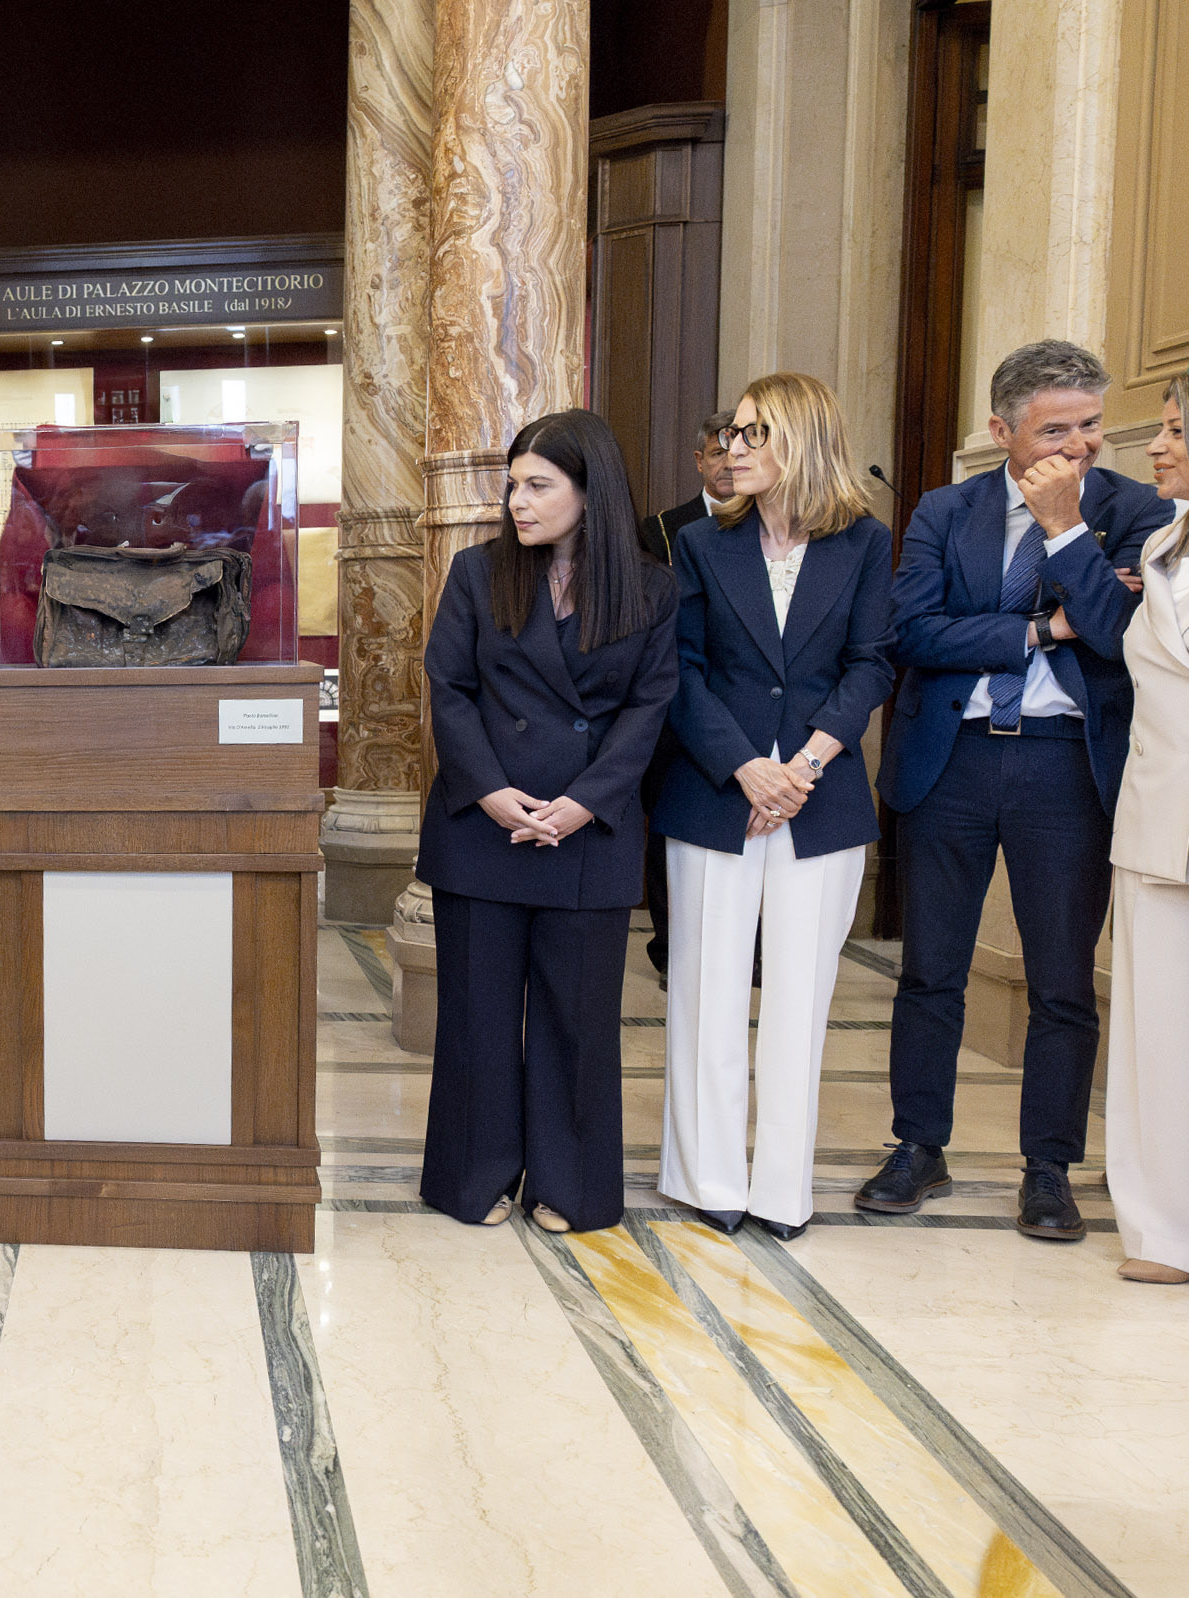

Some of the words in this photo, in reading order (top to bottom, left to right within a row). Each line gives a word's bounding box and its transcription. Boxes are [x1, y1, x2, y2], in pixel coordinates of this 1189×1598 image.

[2, 285, 53, 302] AULE
[58, 283, 77, 299] DI
[83, 279, 169, 299] PALAZZO
[174, 273, 324, 294] MONTECITORIO
[7, 306, 62, 320] L'AULA
[65, 305, 81, 318] DI
[86, 302, 155, 317] ERNESTO
[159, 300, 213, 314] BASILE
[224, 298, 250, 313] (dal
[255, 296, 292, 311] 1918)
